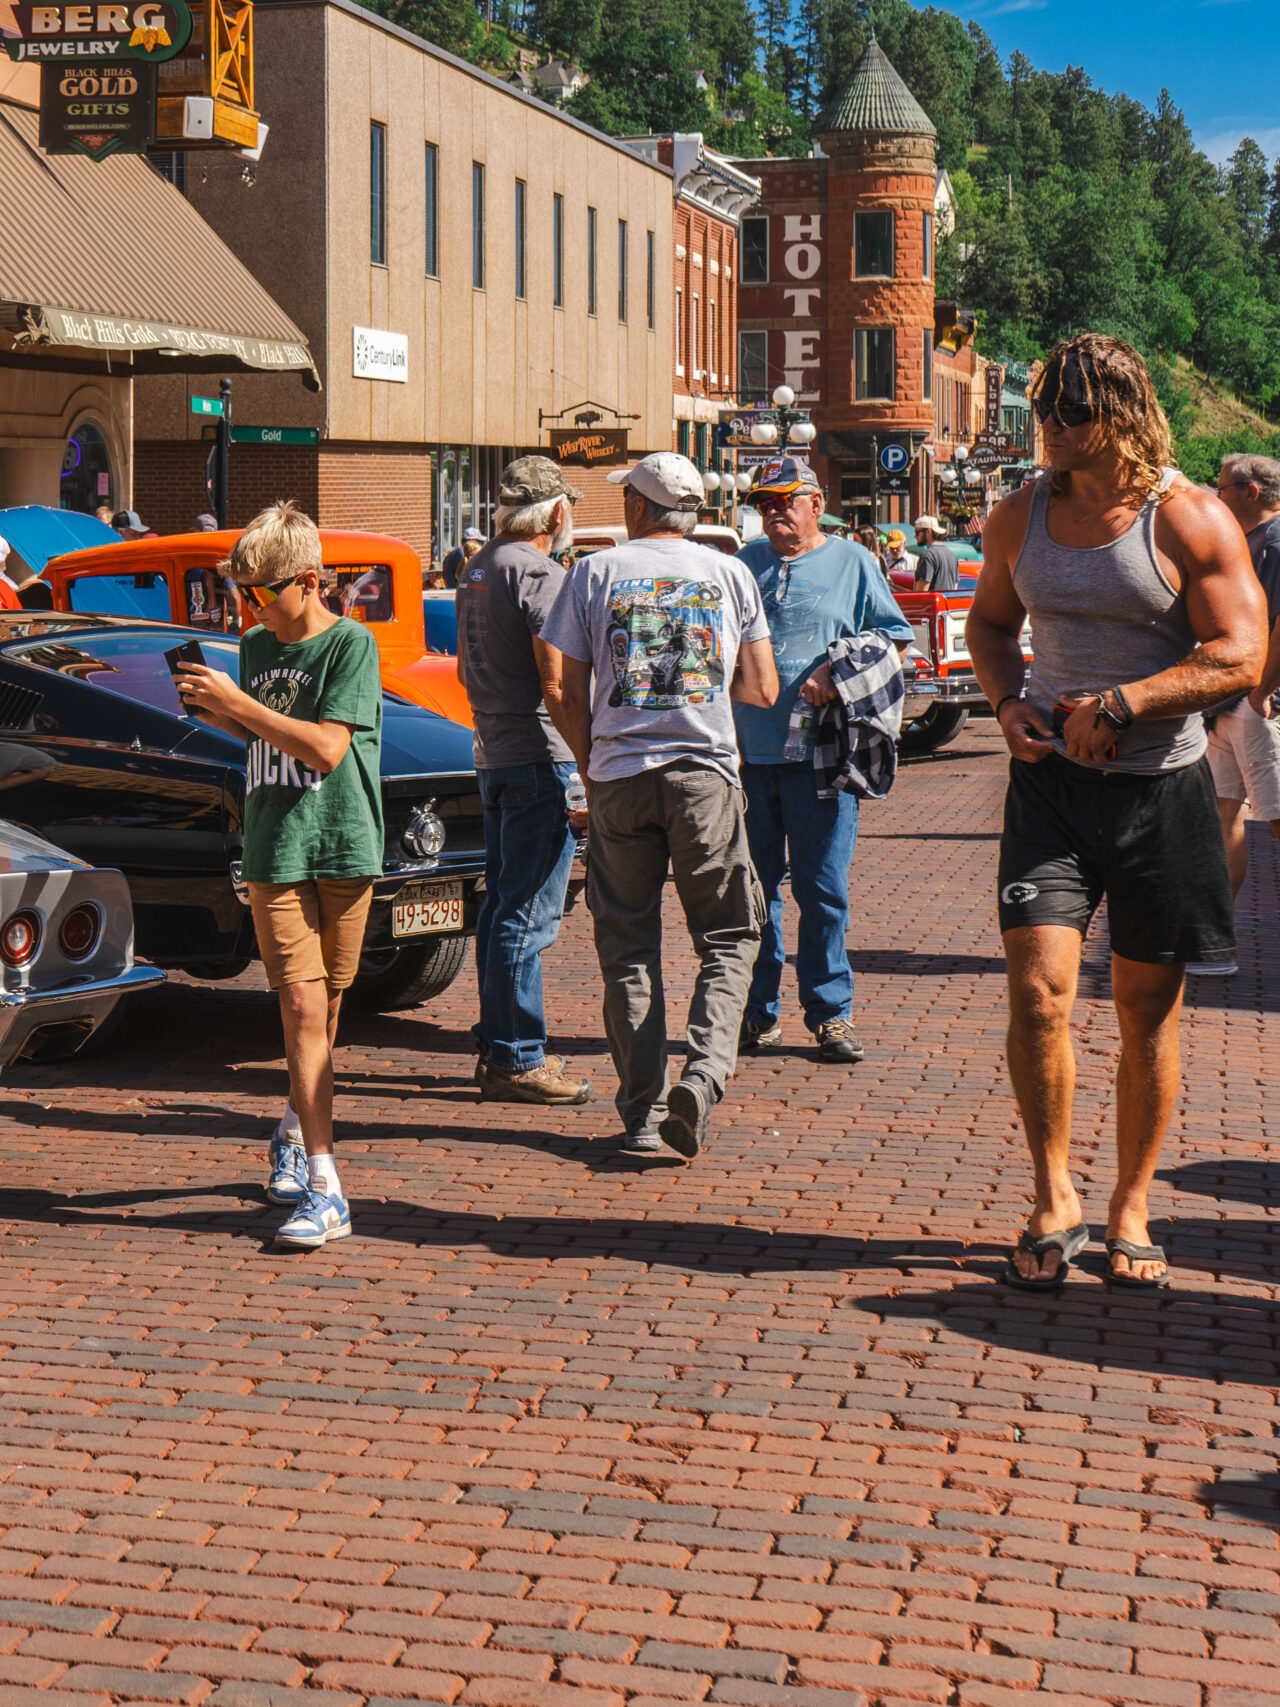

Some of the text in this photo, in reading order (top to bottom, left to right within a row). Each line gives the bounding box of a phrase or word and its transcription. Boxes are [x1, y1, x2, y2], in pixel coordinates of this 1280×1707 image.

[31, 4, 165, 34] BERG
[17, 41, 120, 60] JEWELRY
[64, 68, 132, 77] BLACK HILLS
[59, 77, 138, 97] GOLD
[67, 103, 130, 115] GIFTS
[782, 214, 823, 401] HOTEL
[94, 319, 125, 344] Hills
[123, 323, 160, 345] Gold
[369, 345, 406, 370] CenturyLink
[988, 370, 998, 399] WILD
[261, 429, 282, 441] Gold
[979, 436, 1007, 446] BAR
[888, 448, 904, 469] P
[967, 455, 1014, 464] STAURANT
[611, 578, 653, 589] KING
[250, 668, 314, 689] MILWAUKEE
